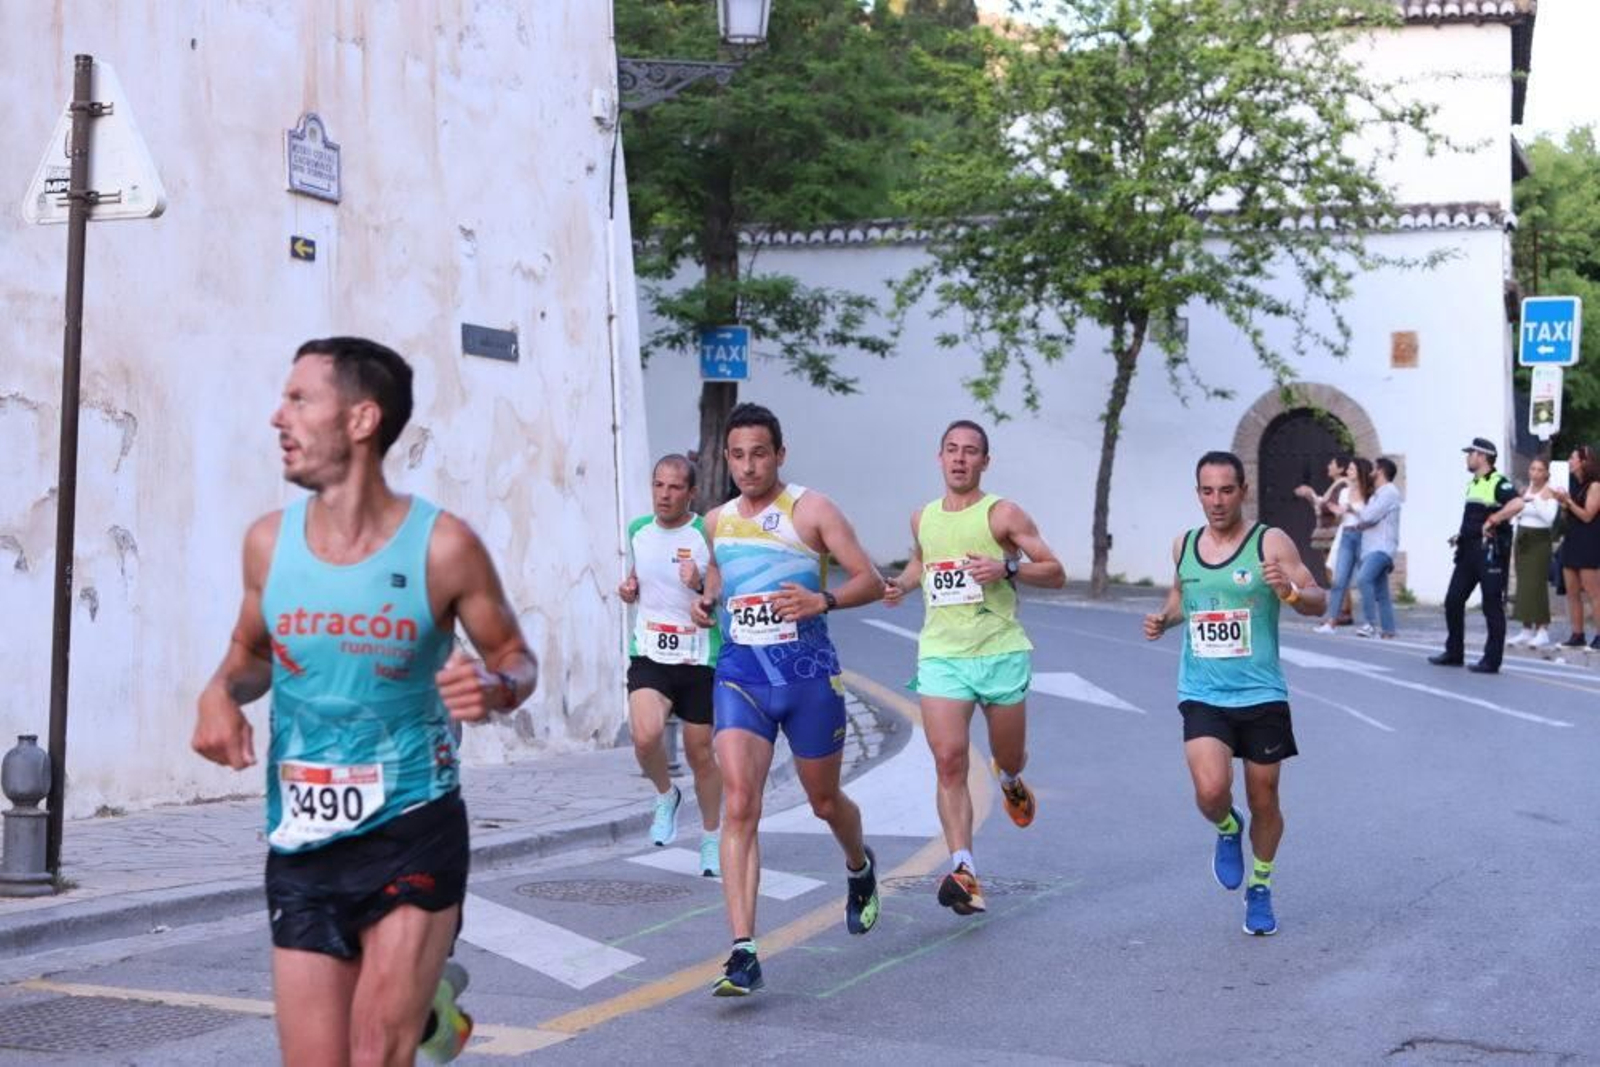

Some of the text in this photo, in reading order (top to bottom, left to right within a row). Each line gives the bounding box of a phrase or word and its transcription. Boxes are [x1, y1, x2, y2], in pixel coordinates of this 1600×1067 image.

[46, 180, 70, 193] MP
[1525, 320, 1572, 342] TAXI
[703, 344, 747, 362] TAXI
[933, 570, 967, 590] 692
[276, 603, 418, 641] atracón
[1197, 621, 1241, 642] 1580
[340, 641, 416, 660] running
[657, 632, 679, 650] 89
[289, 784, 363, 821] 3490
